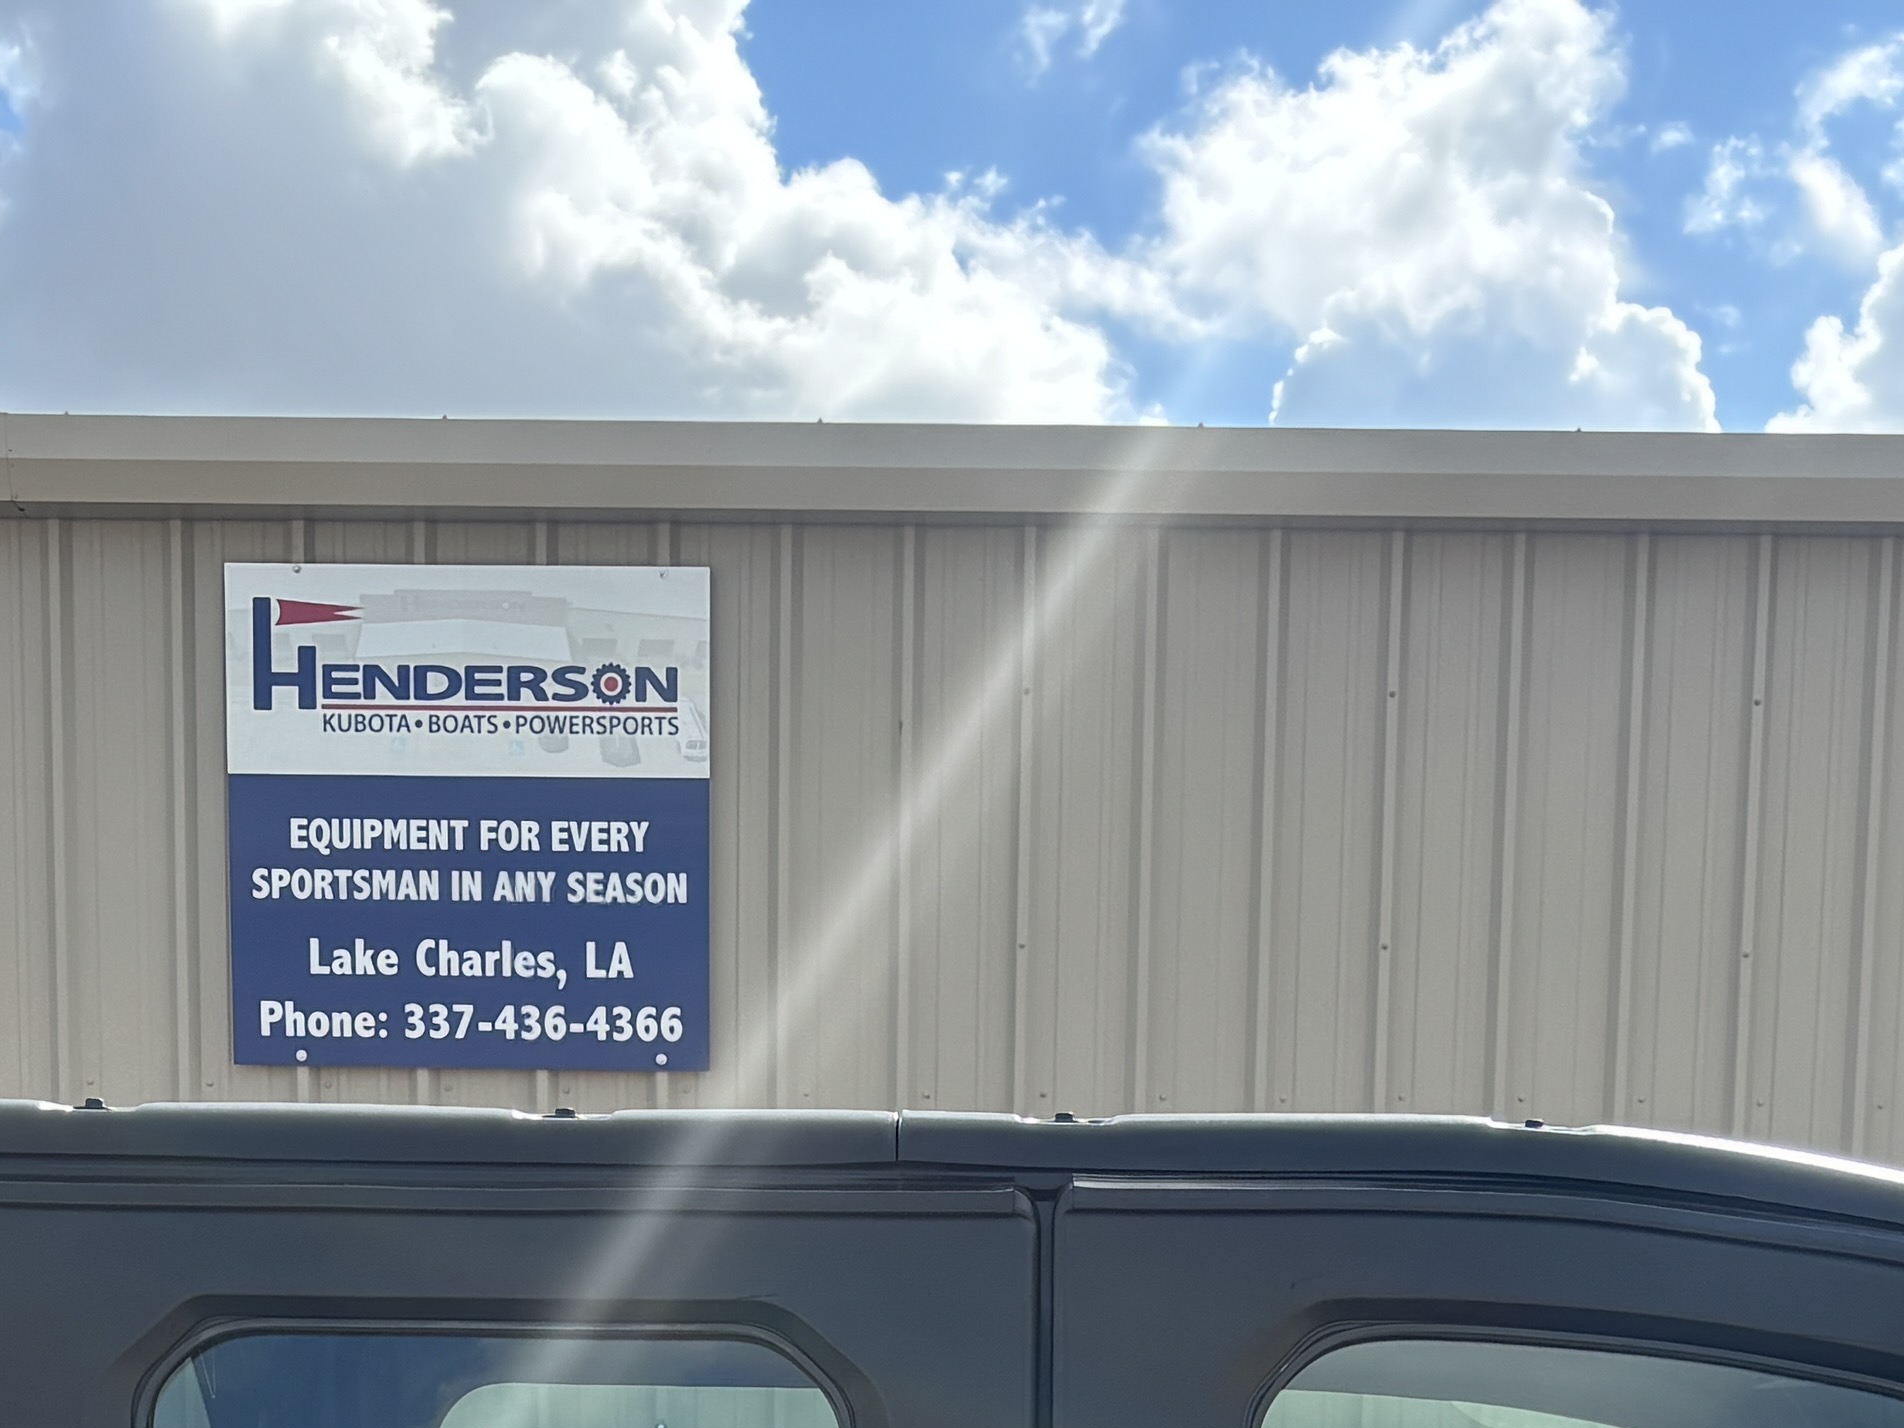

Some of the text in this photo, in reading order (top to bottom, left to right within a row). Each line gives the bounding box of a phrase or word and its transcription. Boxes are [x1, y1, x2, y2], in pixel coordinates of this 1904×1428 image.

[253, 597, 678, 710] HENDERSON
[323, 713, 680, 737] KUBOTA BOATS POWERSPORTS
[289, 817, 650, 855] EQUIPMENT FOR EVERY
[252, 868, 688, 904] SPORTSMAN IN ANY SEASON
[309, 937, 635, 990] Lake Charles, LA
[259, 1000, 684, 1042] Phone: 337-436-4366
